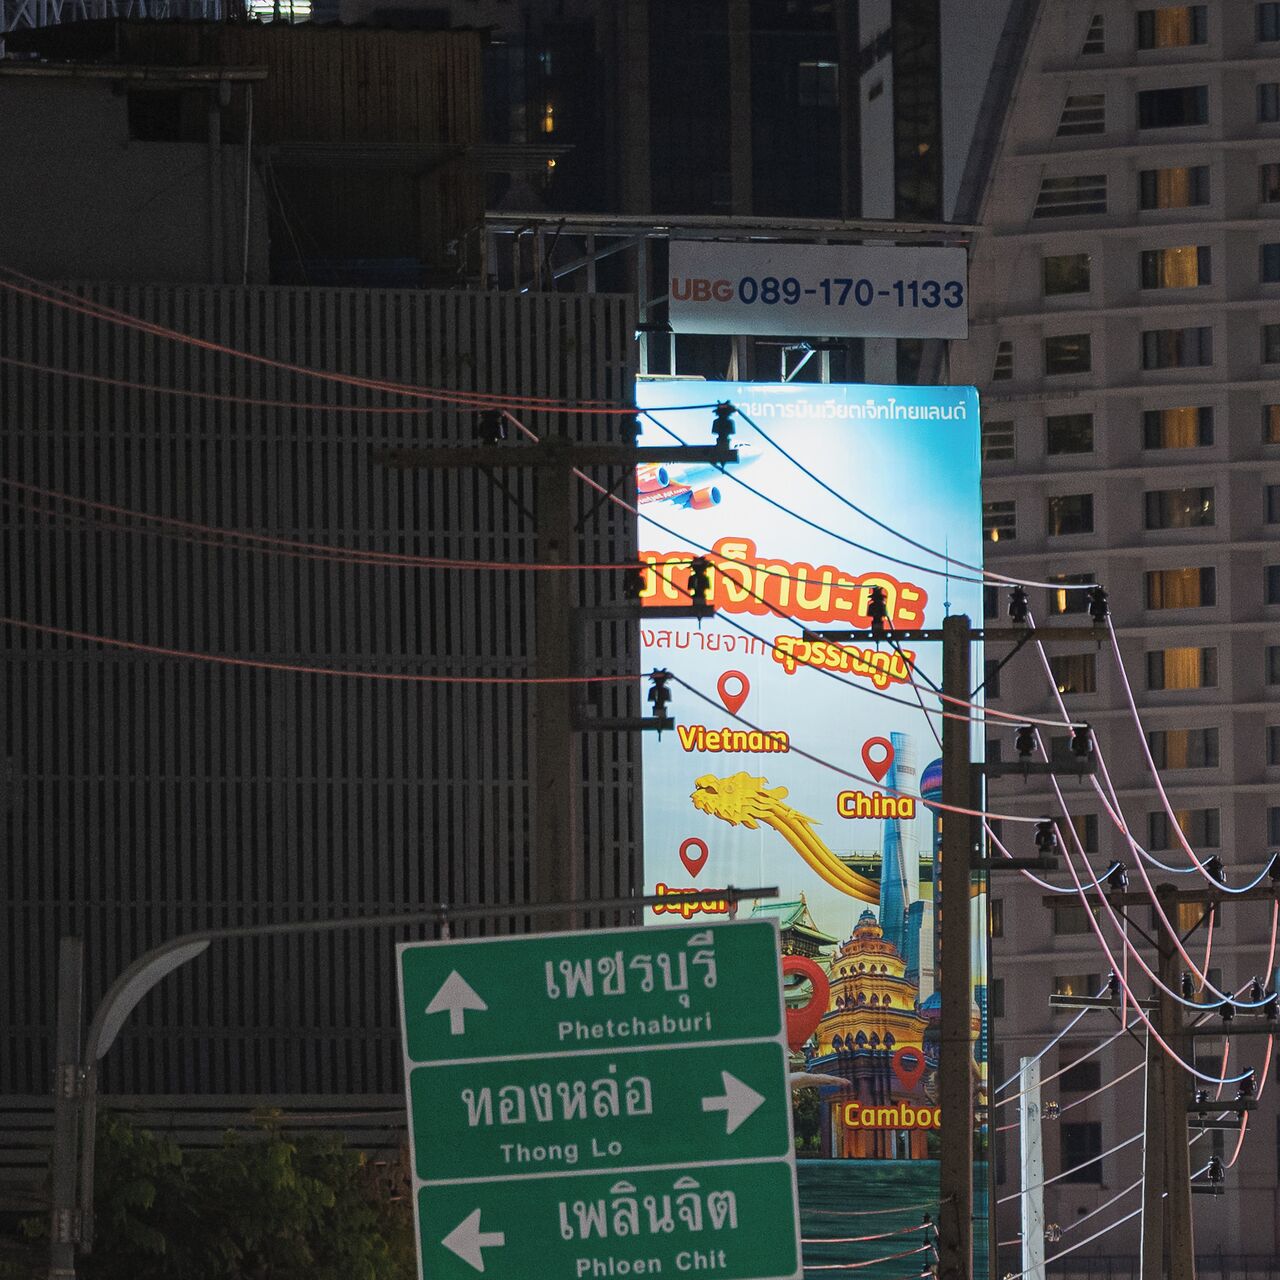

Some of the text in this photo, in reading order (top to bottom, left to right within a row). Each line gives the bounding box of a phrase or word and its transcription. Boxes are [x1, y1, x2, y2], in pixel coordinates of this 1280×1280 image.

[671, 276, 965, 309] UBG 089-170-1133
[678, 725, 789, 753] Vietnam
[838, 791, 915, 818] China
[544, 930, 719, 1008] เพชรบุรี
[558, 1012, 713, 1041] Phetchaburi
[461, 1064, 654, 1127] ทองหล่อ
[500, 1138, 623, 1164] Thong Lo
[558, 1176, 739, 1241] เพลินจิต
[576, 1249, 728, 1279] Phloen Chit
